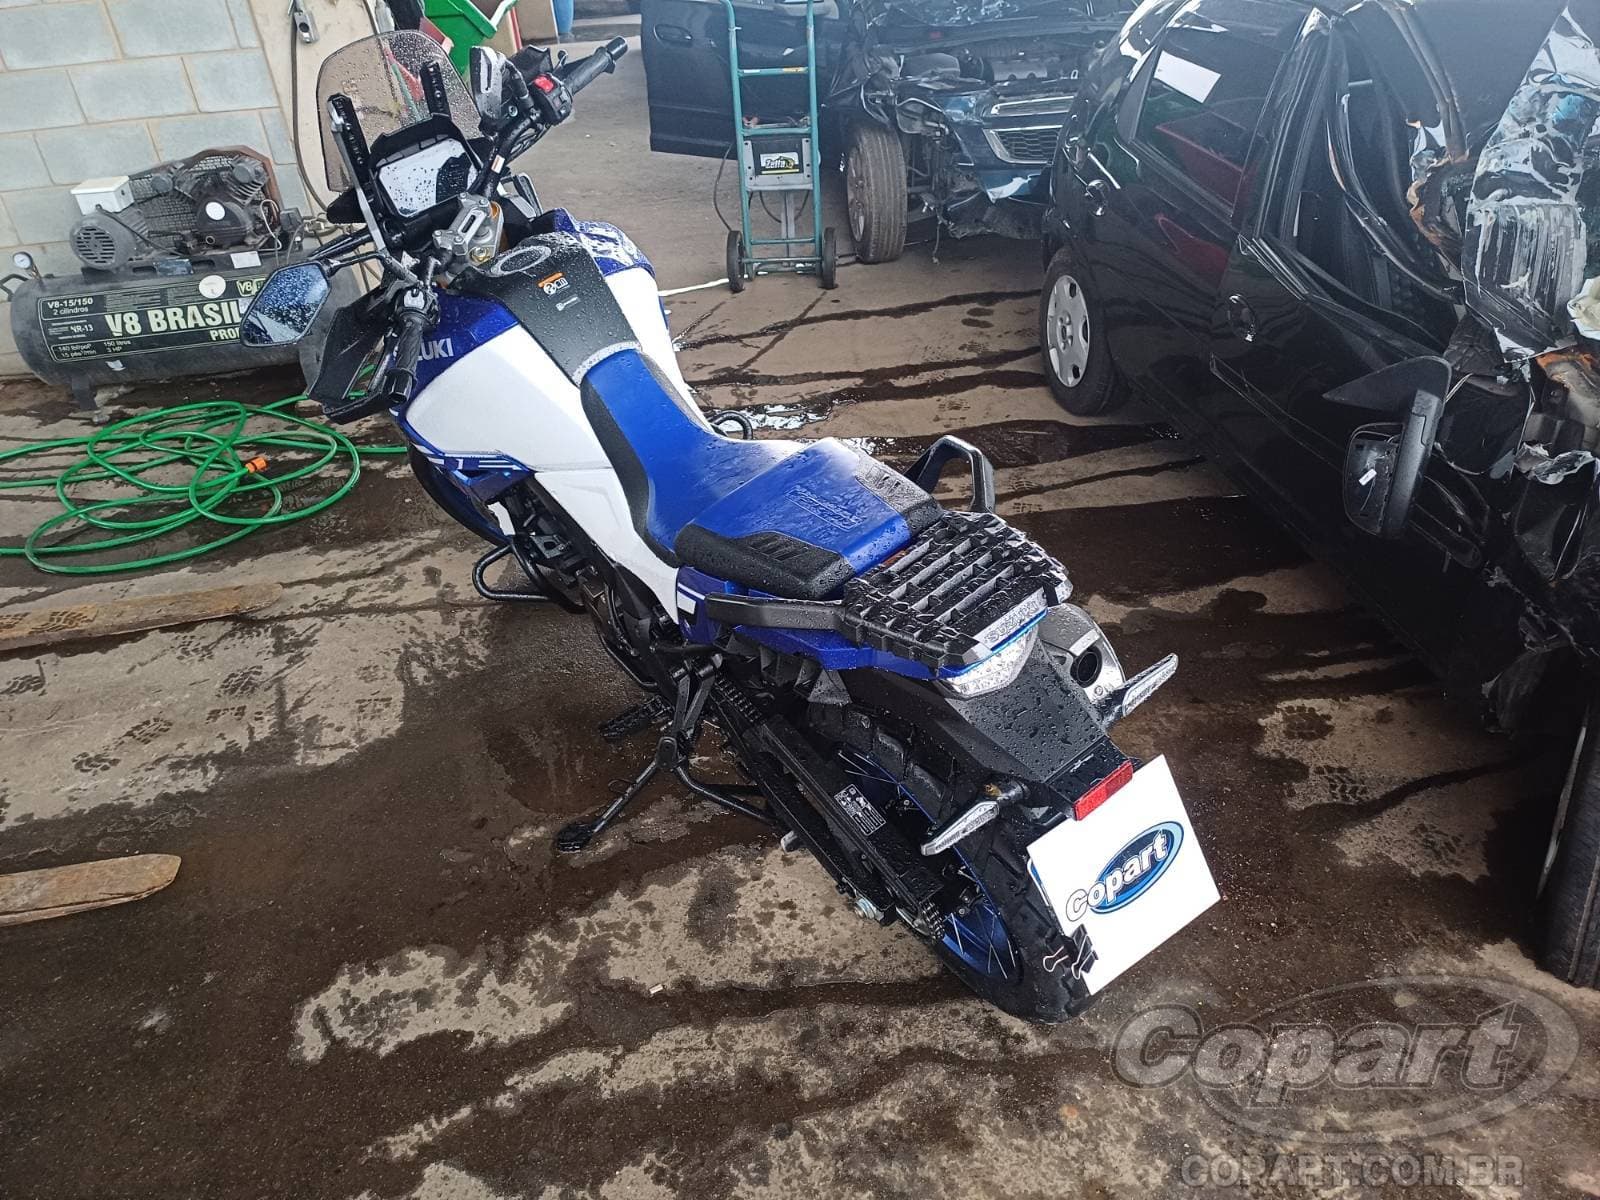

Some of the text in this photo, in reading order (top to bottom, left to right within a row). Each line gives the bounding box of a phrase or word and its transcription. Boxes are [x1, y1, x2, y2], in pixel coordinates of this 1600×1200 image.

[238, 281, 252, 293] V8
[47, 297, 94, 309] V8-15/150
[60, 306, 89, 315] cilindros
[104, 300, 241, 337] V8 BRASIL
[983, 600, 1040, 642] SUZUKI
[1066, 829, 1169, 922] Copart
